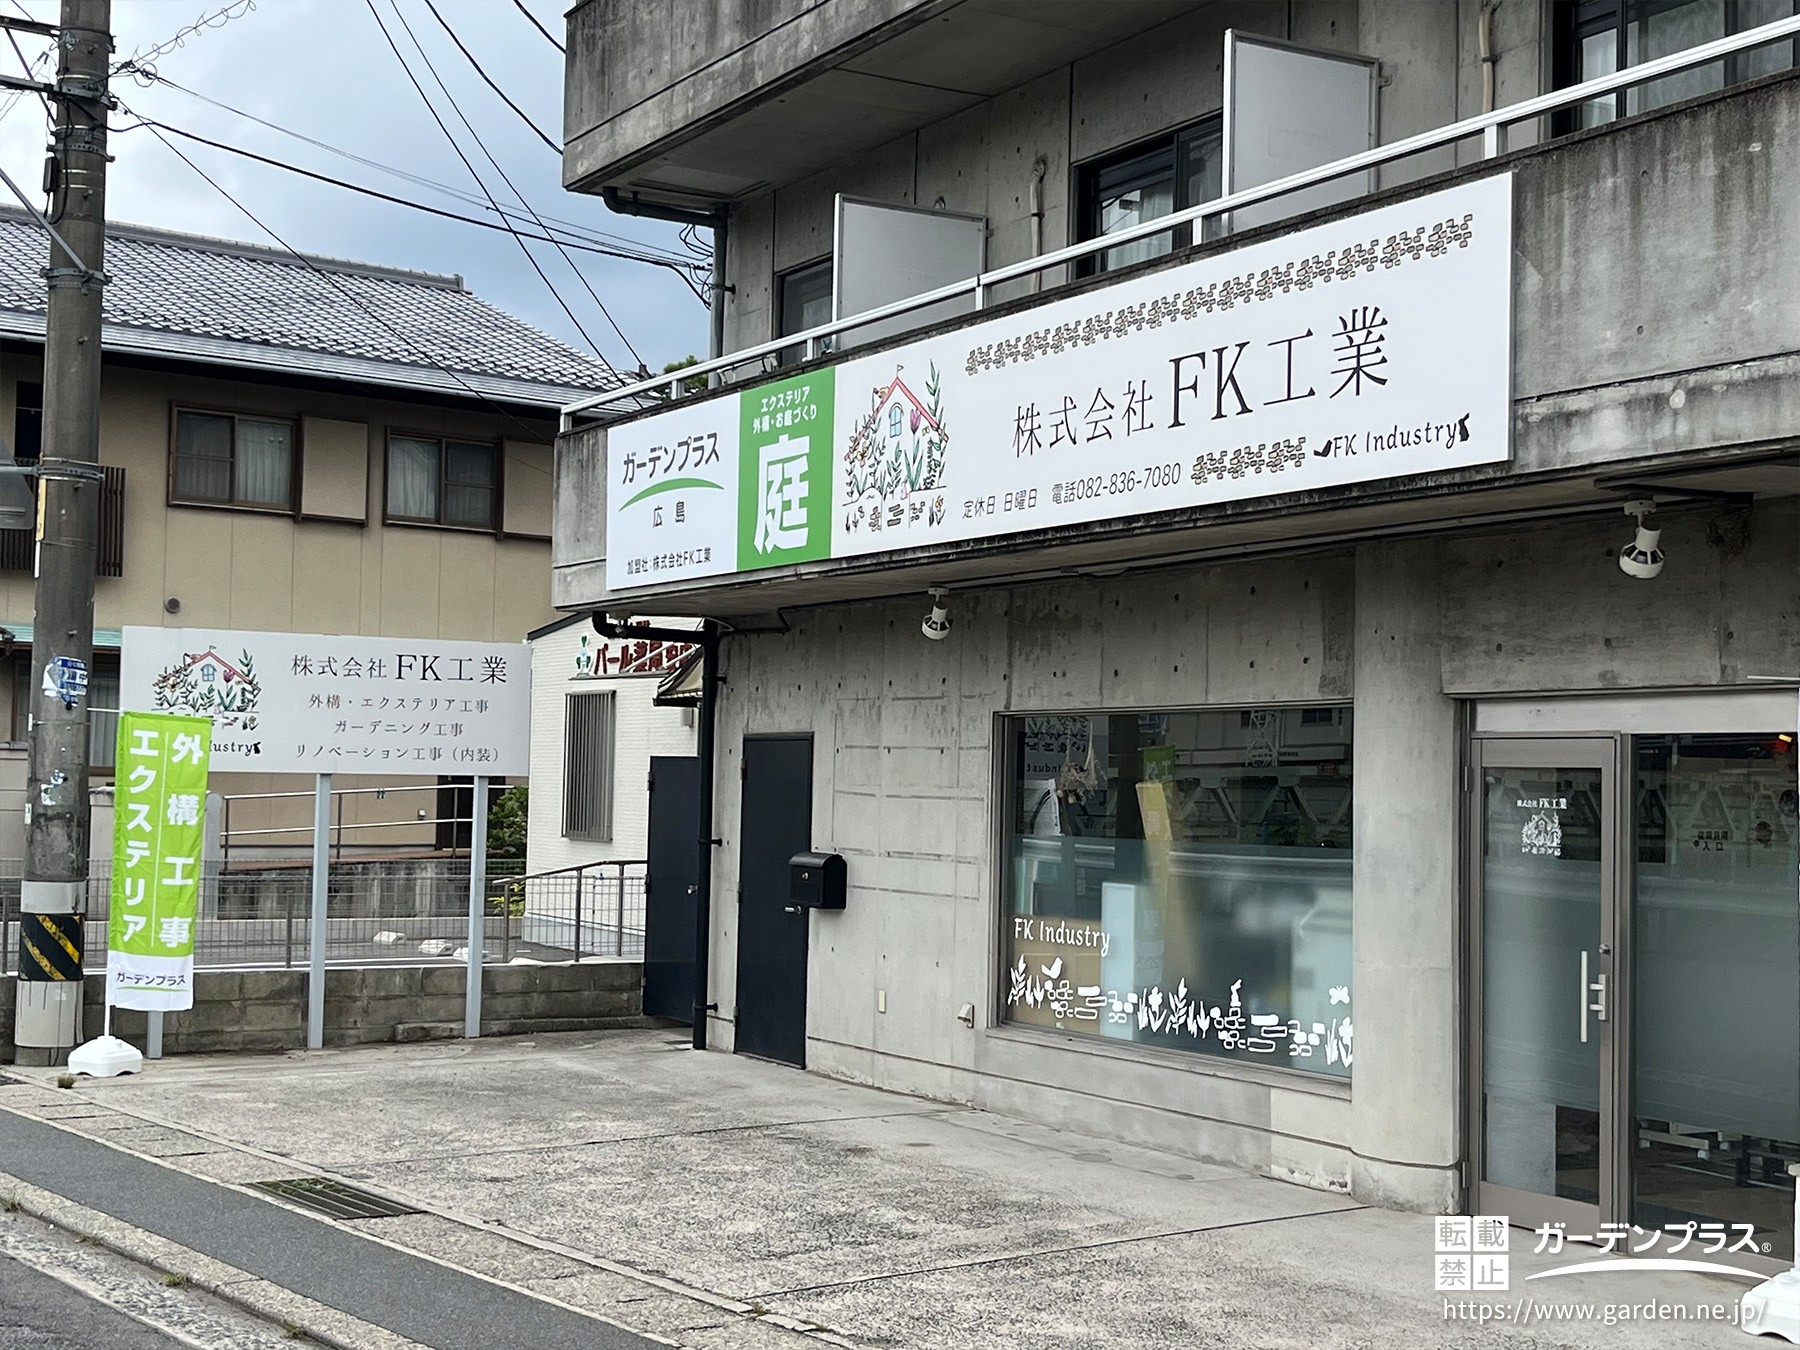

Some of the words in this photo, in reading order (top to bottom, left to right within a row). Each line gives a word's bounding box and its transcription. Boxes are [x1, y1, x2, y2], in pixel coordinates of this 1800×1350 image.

[761, 386, 811, 413] エクステリア
[753, 404, 817, 434] 外構・お庭づくり
[1332, 432, 1358, 459] FK
[1365, 419, 1457, 454] Industry
[622, 432, 720, 485] ガーデンプラス
[754, 433, 811, 555] 庭
[962, 495, 996, 519] 定休日
[1003, 488, 1038, 513] 日曜日
[652, 500, 686, 528] 広島
[308, 693, 489, 714] 外構・エクステリア工事
[334, 720, 464, 737] ガーデニング工事
[122, 729, 160, 943] エクステリア
[158, 733, 204, 948] 外構工事
[1014, 917, 1034, 941] FK
[1039, 920, 1111, 957] Industry
[116, 971, 186, 987] ガーデンプラス
